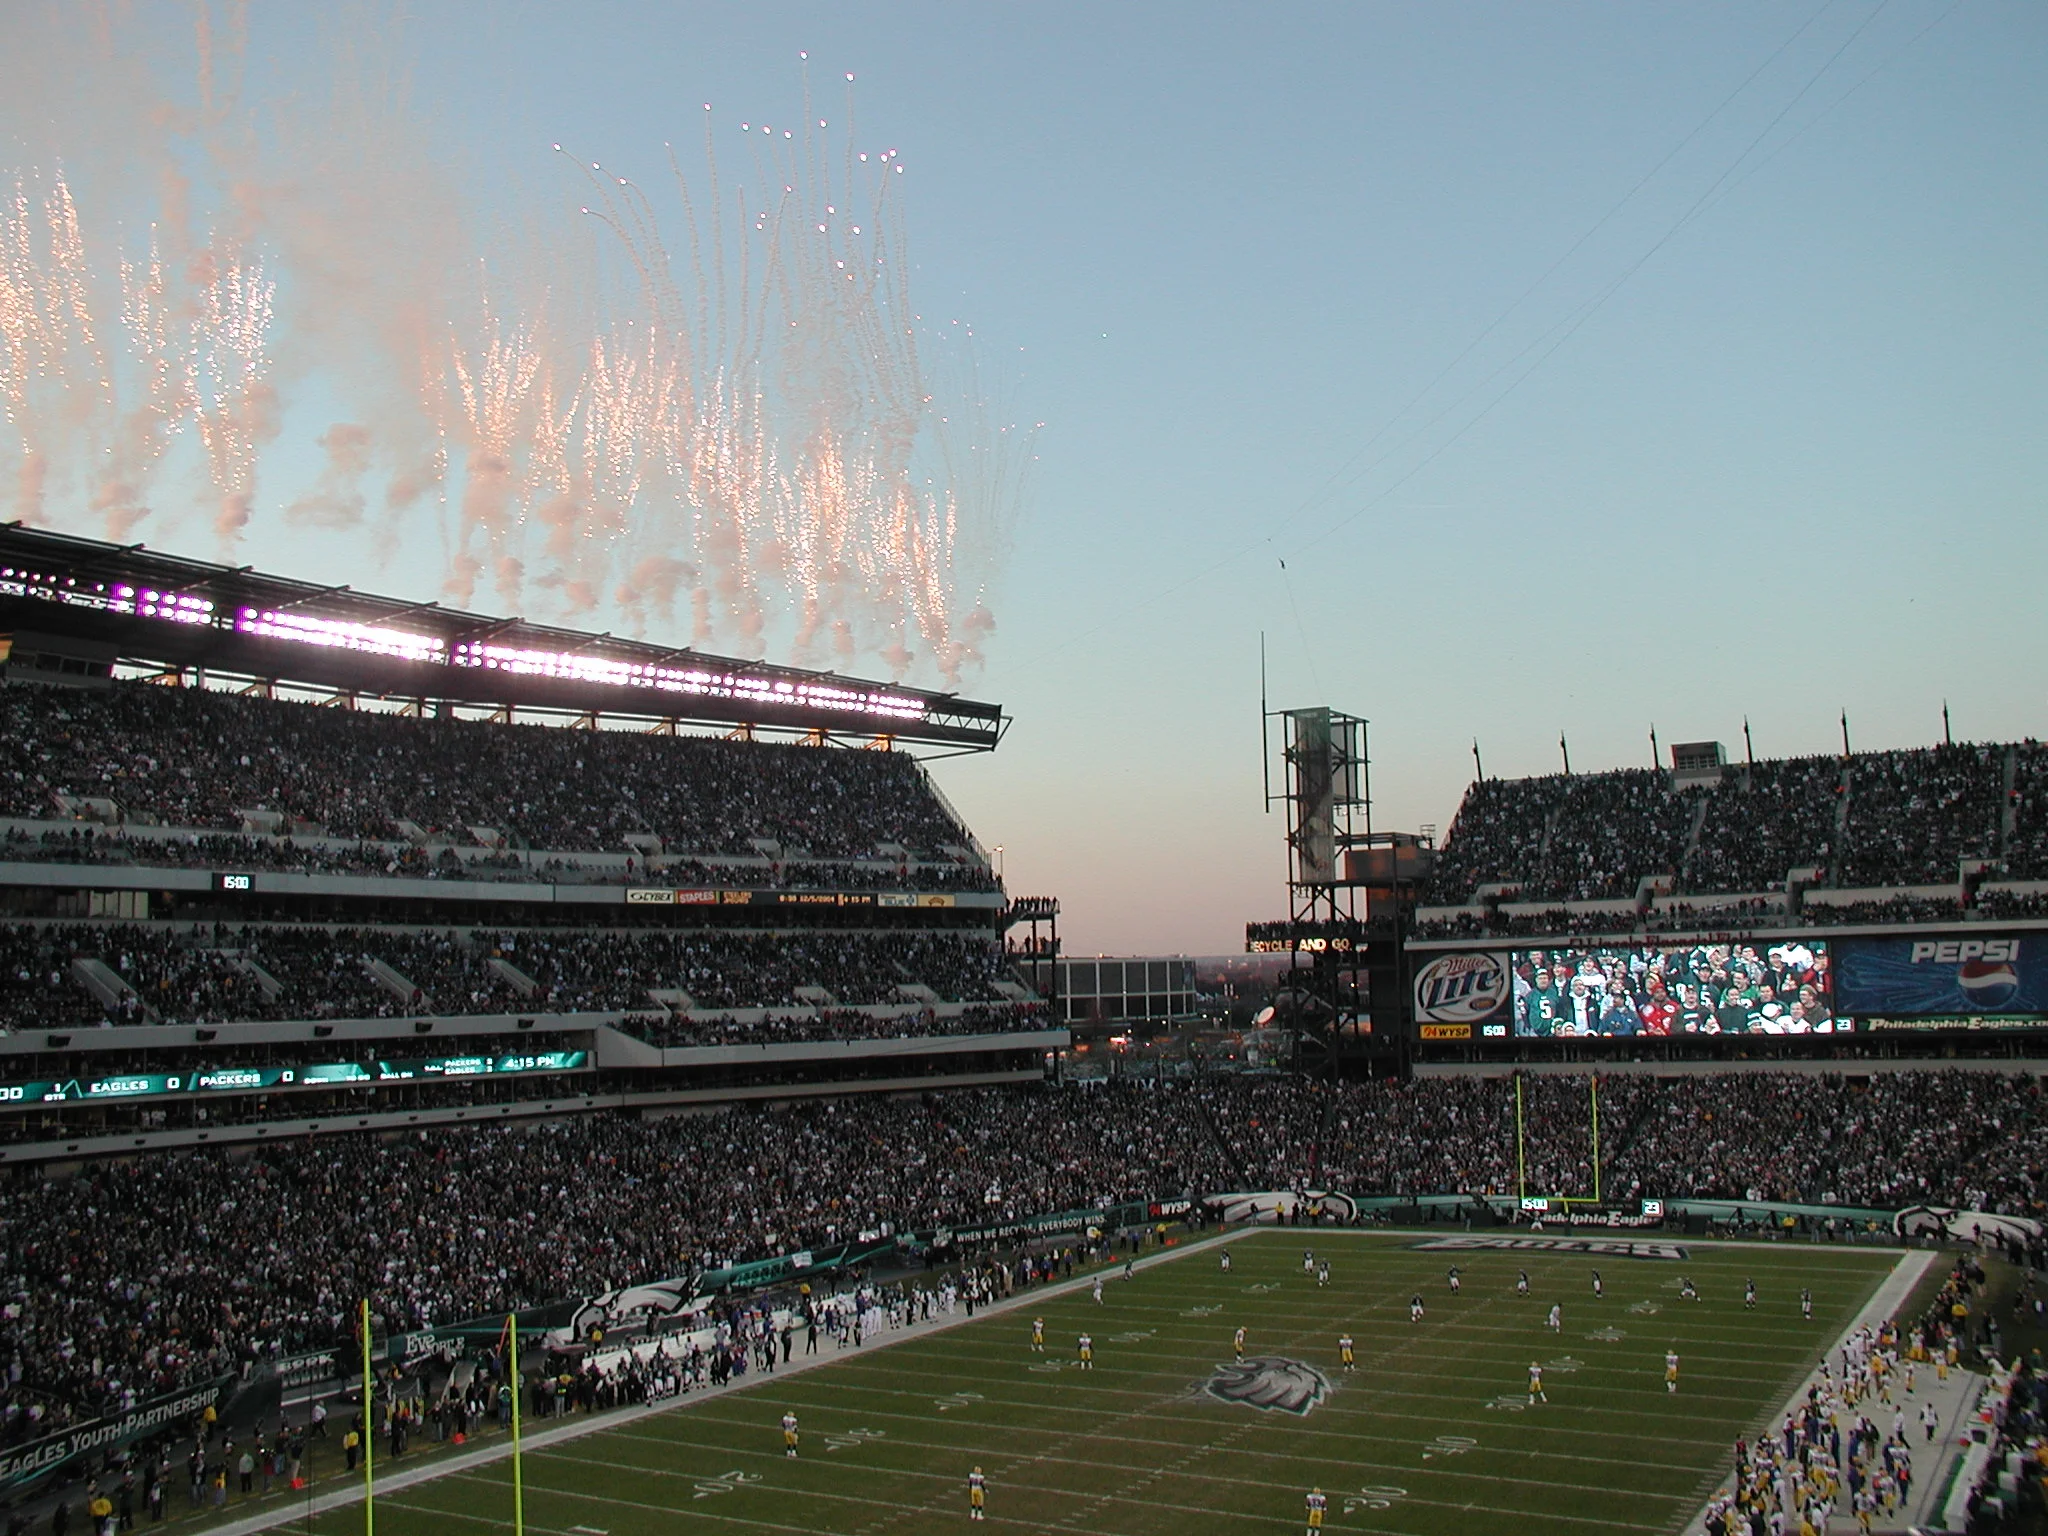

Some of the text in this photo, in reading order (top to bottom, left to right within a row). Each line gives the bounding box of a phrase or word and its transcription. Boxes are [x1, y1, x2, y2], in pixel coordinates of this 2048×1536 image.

[680, 891, 714, 903] STAPLES
[1299, 938, 1327, 951] AND
[1911, 939, 2020, 963] PEPSI
[1447, 957, 1488, 972] Miller
[1425, 967, 1501, 1010] Lite
[1538, 1000, 1553, 1018] 5
[1438, 1027, 1469, 1038] WYSP
[505, 1057, 535, 1068] 4:15
[91, 1080, 149, 1093] EAGLES
[200, 1073, 261, 1087] PACKERS
[1161, 1201, 1191, 1215] WYSP
[957, 1229, 982, 1243] WHEN
[984, 1227, 997, 1239] WE
[1039, 1216, 1083, 1232] EVERYBODY
[1412, 1237, 1685, 1259] EAGLES
[0, 1386, 220, 1481] EAGLES YOUTH PARTNERSHIP
